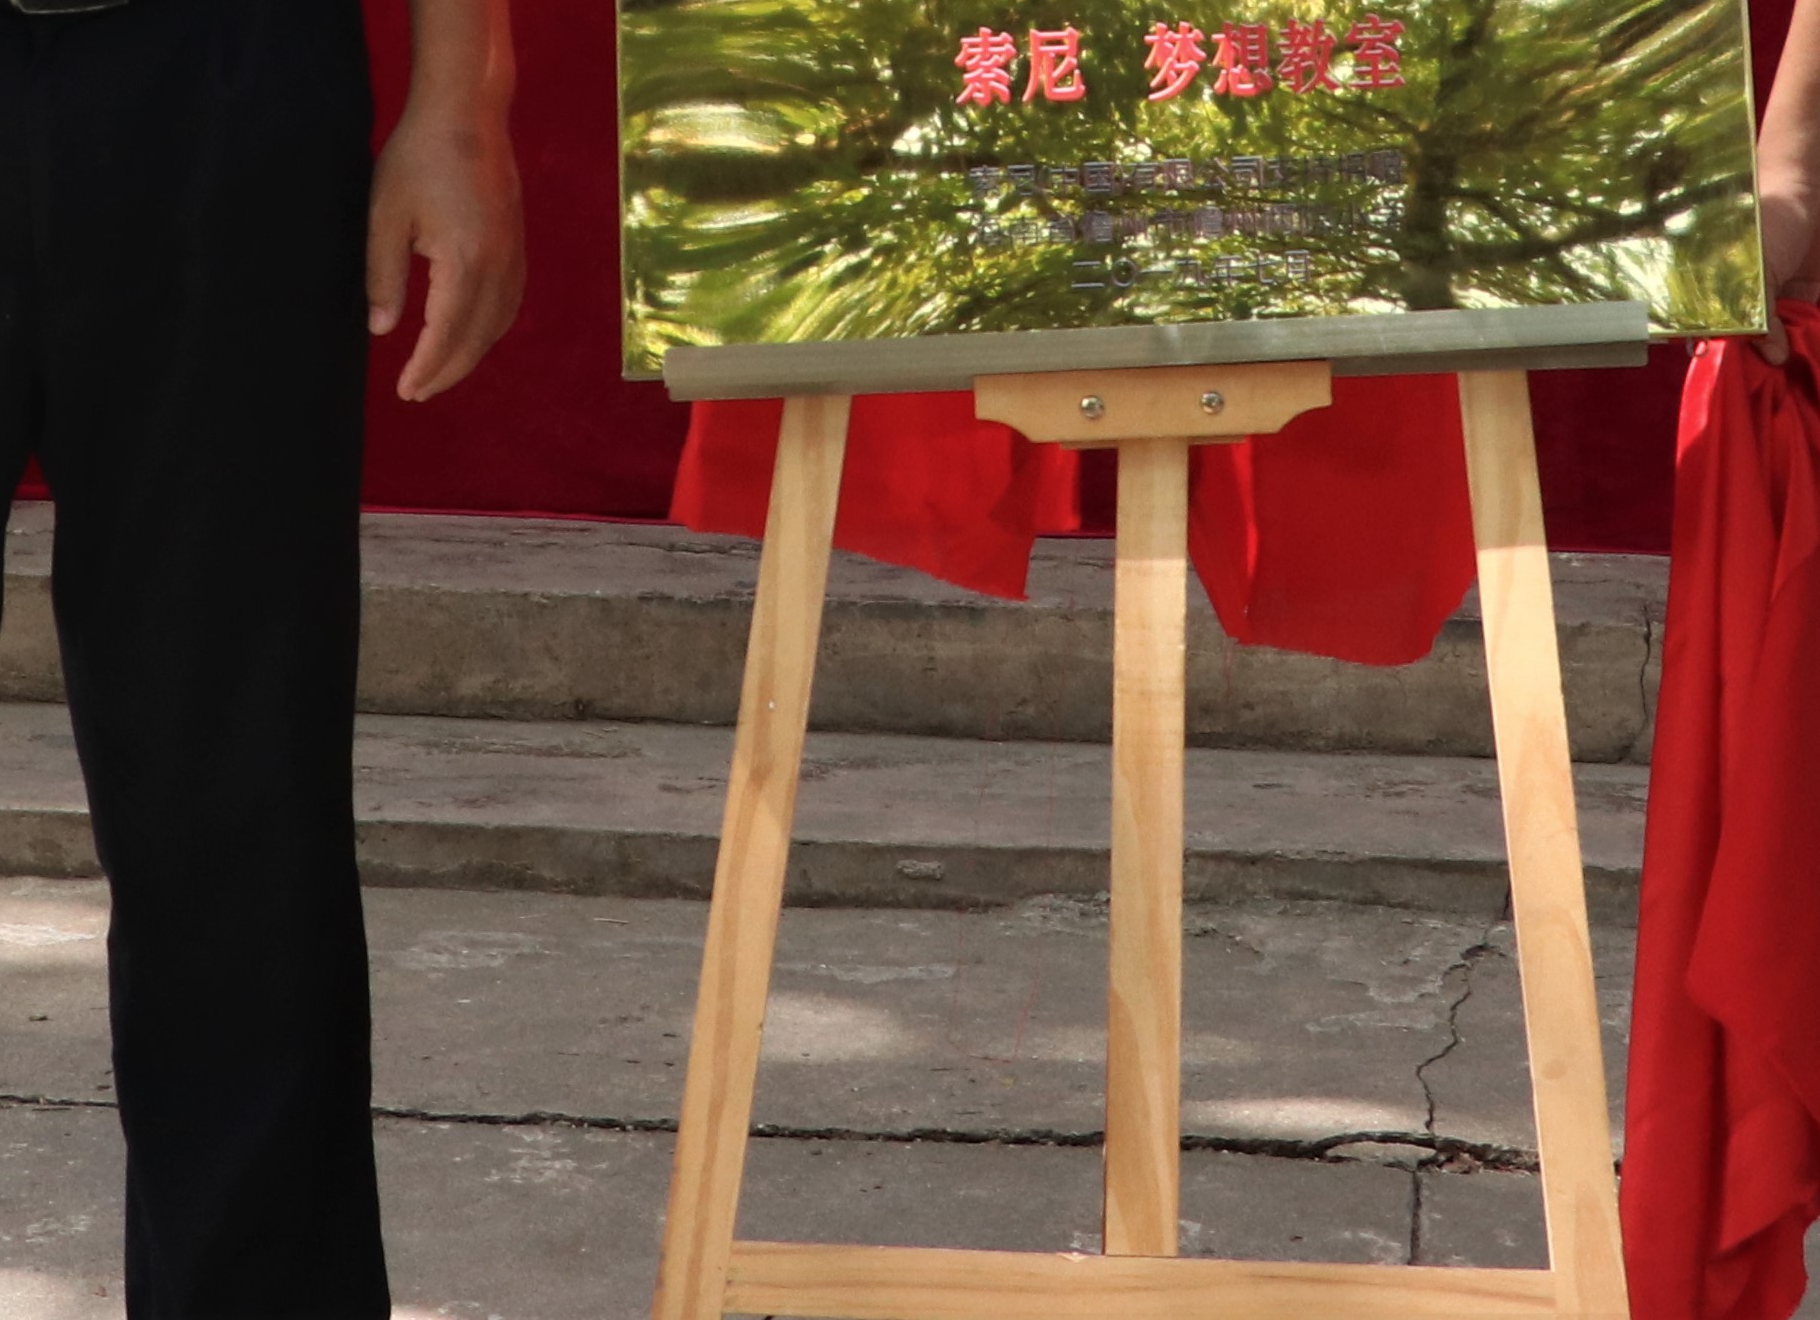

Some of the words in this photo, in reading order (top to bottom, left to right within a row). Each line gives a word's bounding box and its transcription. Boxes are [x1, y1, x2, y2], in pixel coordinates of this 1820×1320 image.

[954, 23, 1087, 107] 索尼
[1143, 13, 1407, 102] 梦想教室
